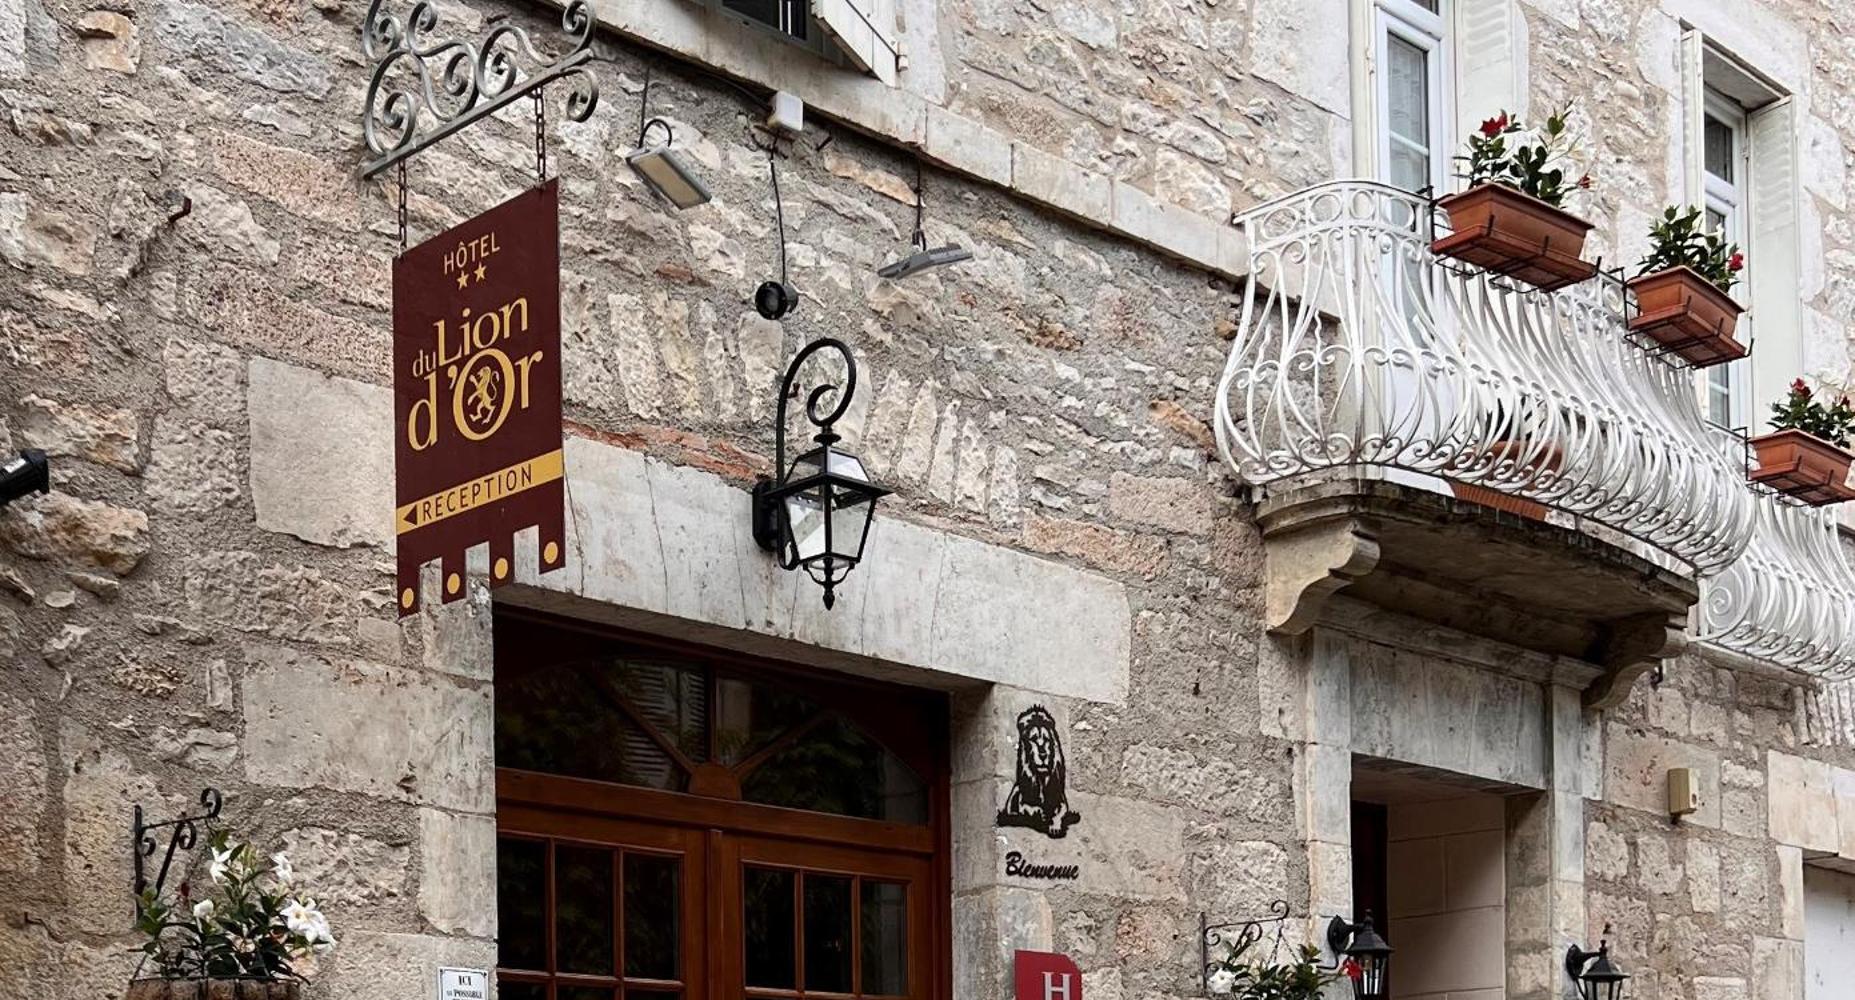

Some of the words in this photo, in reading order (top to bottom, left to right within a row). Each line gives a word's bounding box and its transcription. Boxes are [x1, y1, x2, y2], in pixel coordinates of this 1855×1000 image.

[443, 231, 501, 276] HÔTEL
[413, 349, 436, 378] du
[433, 296, 529, 367] Lion
[407, 347, 543, 452] d'Or
[422, 463, 533, 521] RECEPTION
[1005, 851, 1080, 880] Bienvenue
[458, 975, 472, 986] ICI
